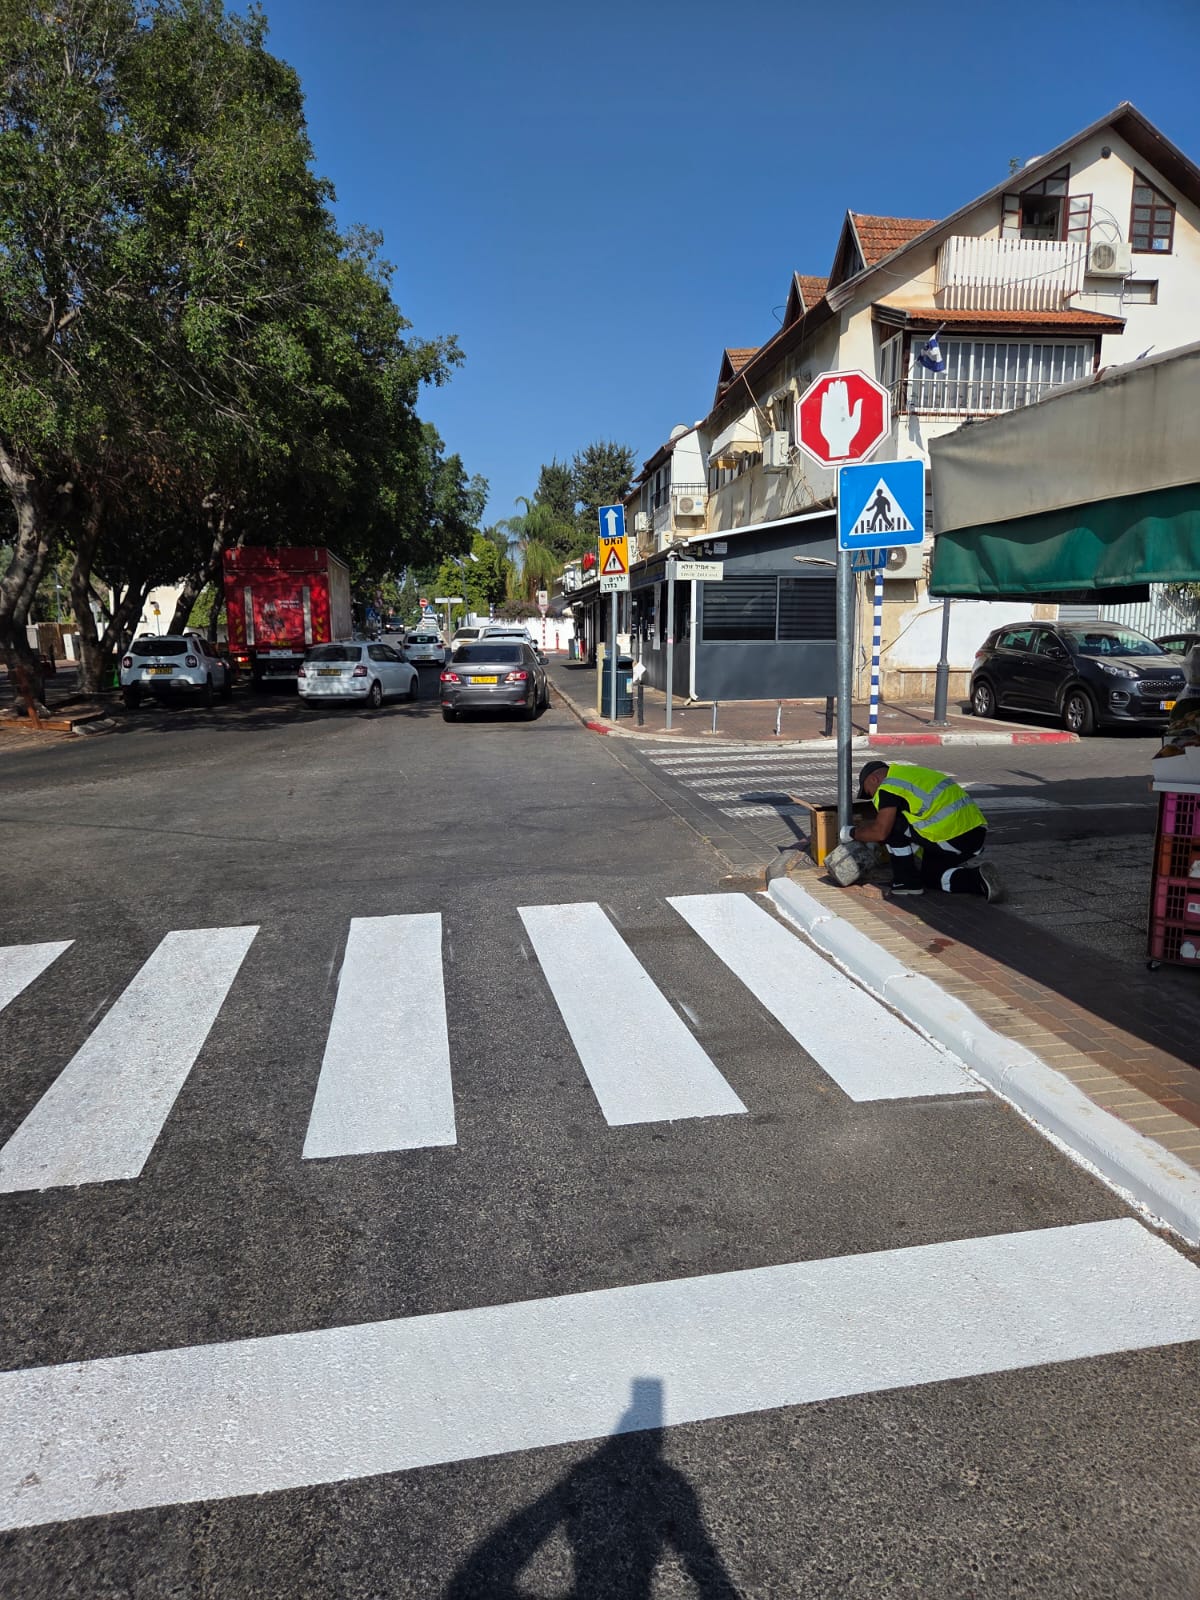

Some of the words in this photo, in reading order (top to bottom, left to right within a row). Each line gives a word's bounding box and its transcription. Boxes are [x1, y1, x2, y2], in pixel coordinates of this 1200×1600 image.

[603, 537, 623, 546] האט
[608, 575, 626, 583] ילדים
[603, 582, 618, 590] בדרך
